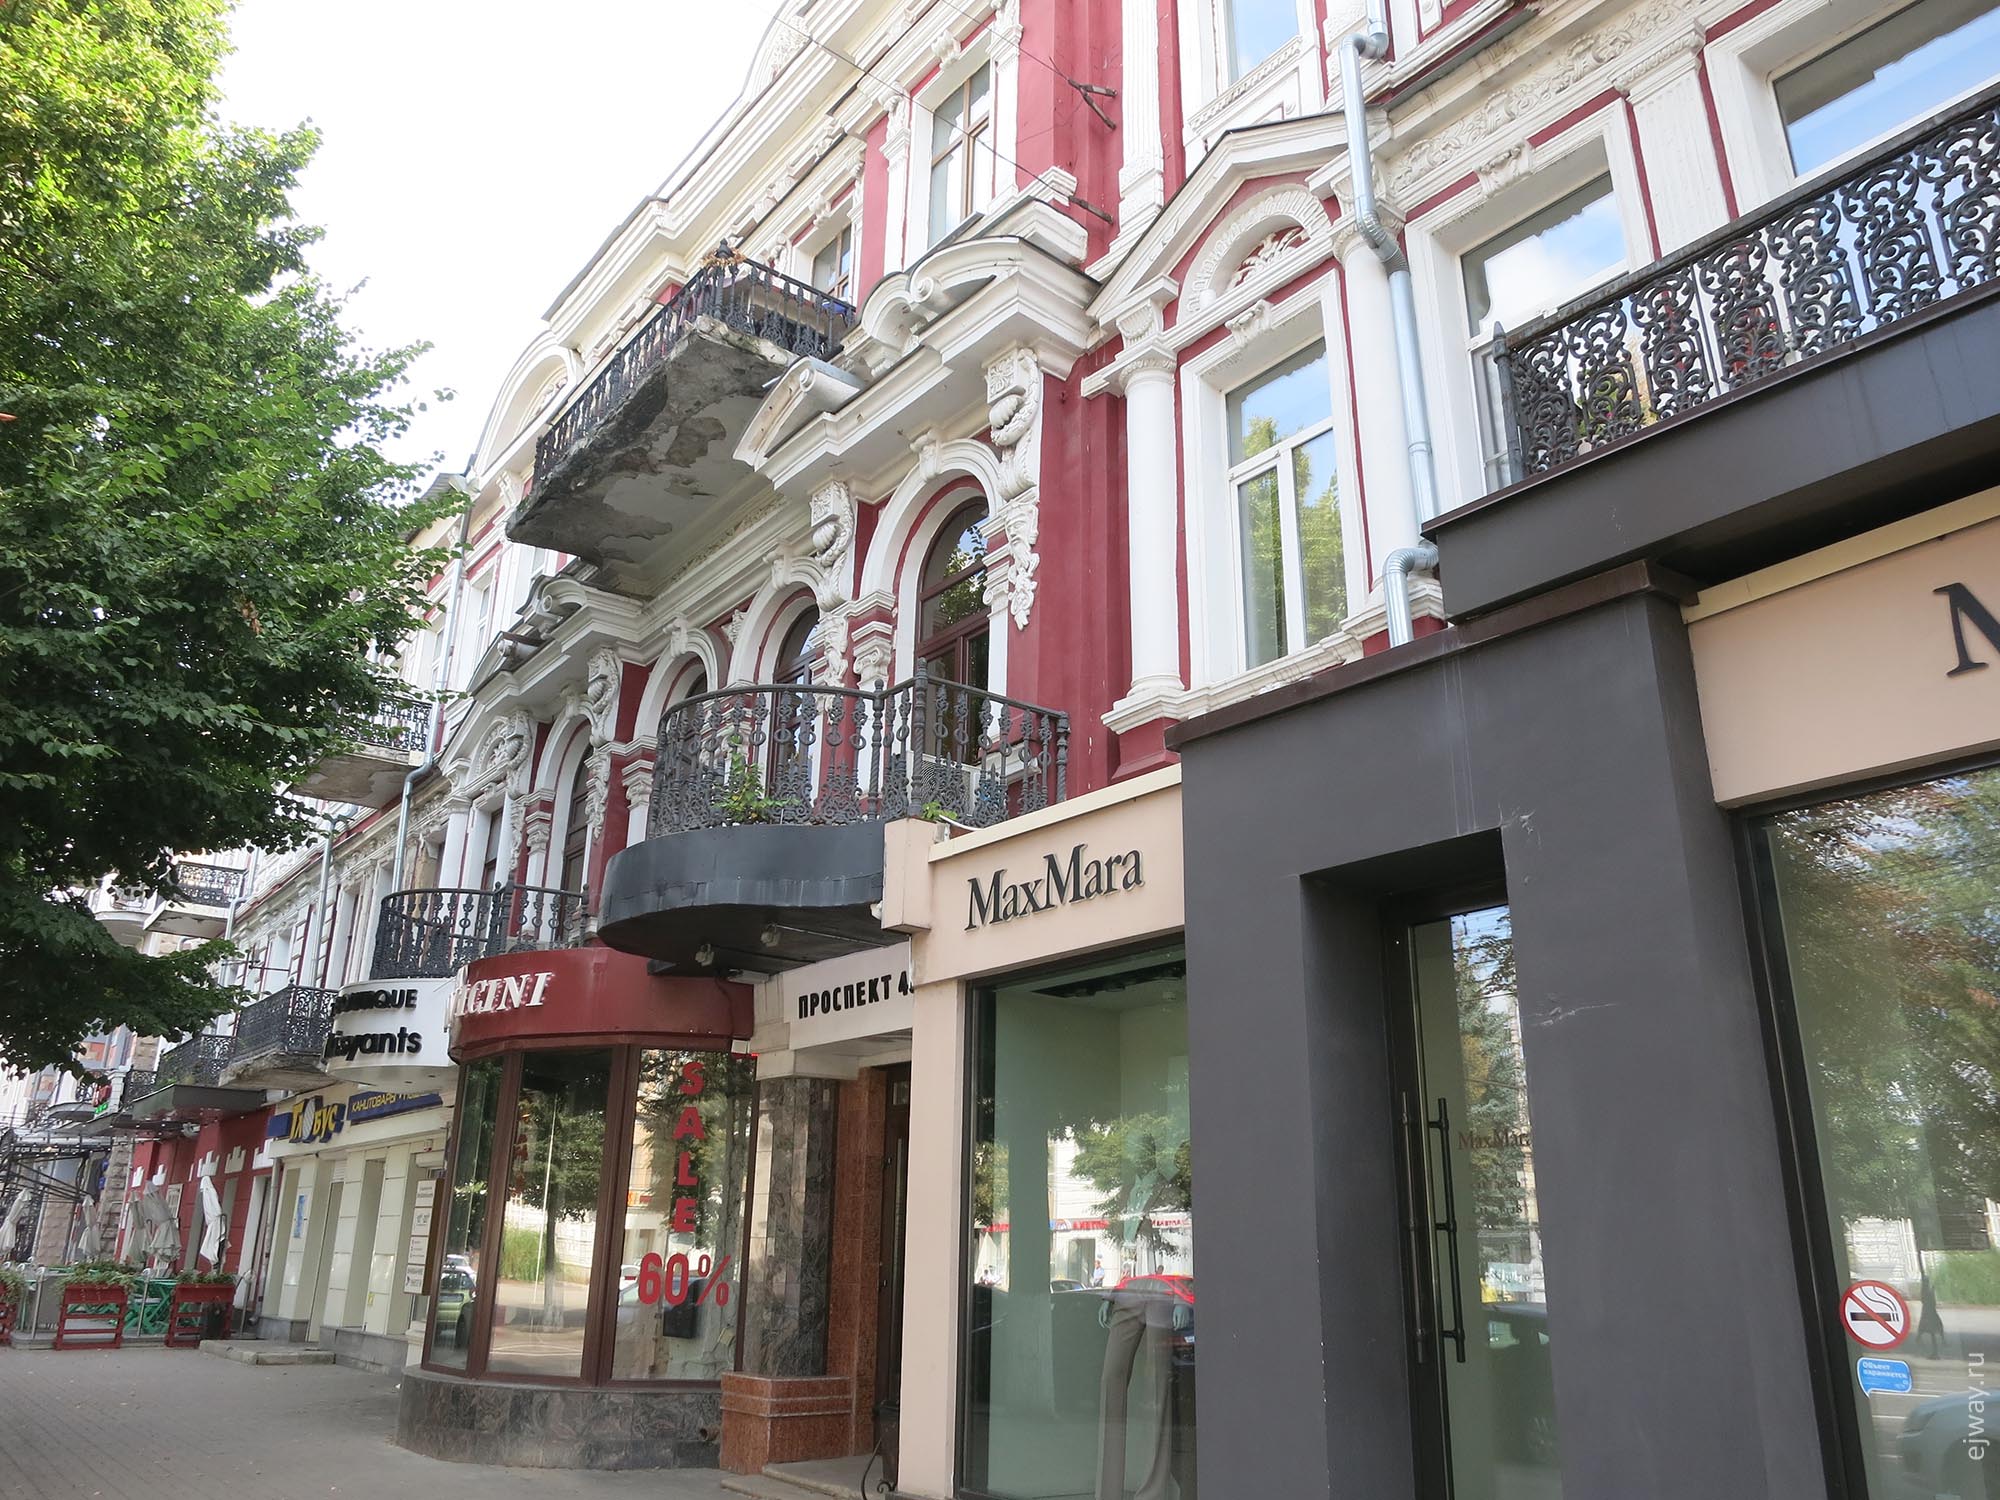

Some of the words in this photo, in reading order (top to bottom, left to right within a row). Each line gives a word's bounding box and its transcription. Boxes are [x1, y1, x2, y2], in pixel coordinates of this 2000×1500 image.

[963, 843, 1144, 931] MaxMara
[798, 974, 892, 1019] ПРОСПЕКТ
[898, 970, 915, 996] 4
[672, 1061, 706, 1233] SALE
[625, 1252, 731, 1307] -60%
